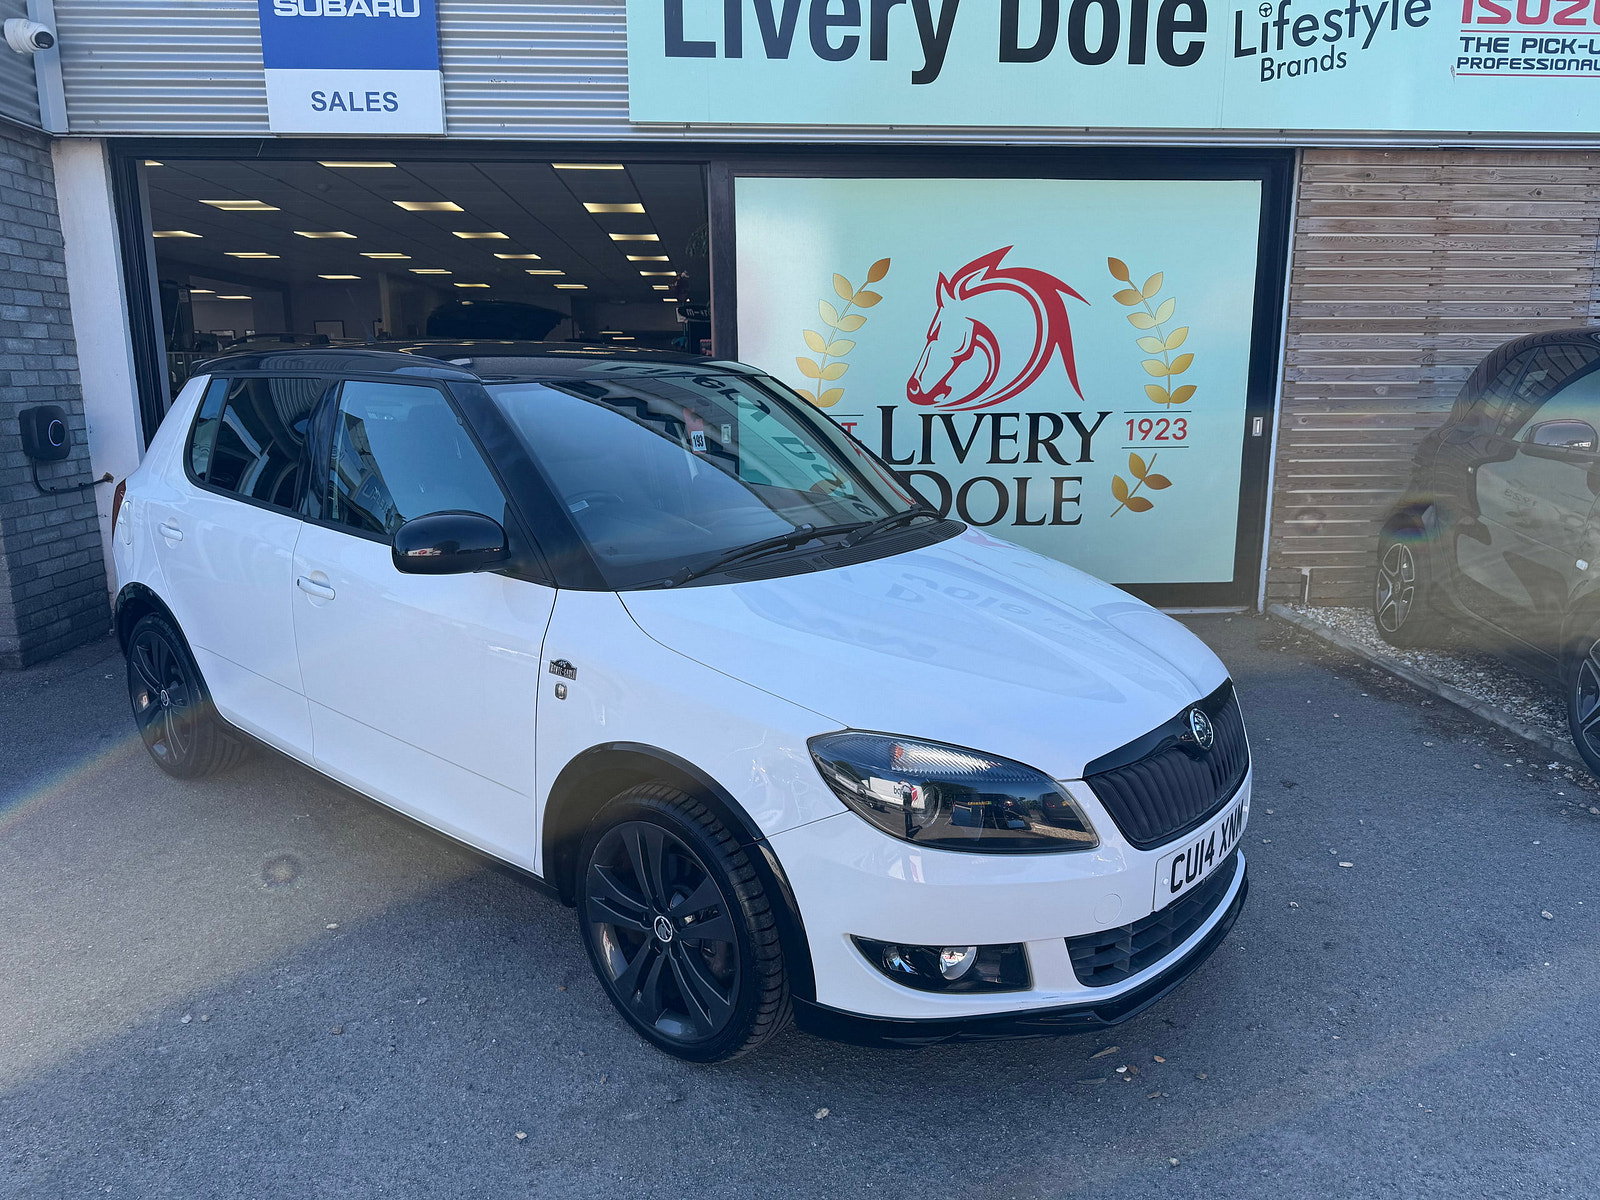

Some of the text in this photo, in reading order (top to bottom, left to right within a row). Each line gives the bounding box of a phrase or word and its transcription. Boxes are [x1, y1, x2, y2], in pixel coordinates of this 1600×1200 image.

[274, 0, 421, 18] SUBARU
[1461, 0, 1600, 25] ISUZ
[664, 0, 1207, 85] Livery Dole
[1234, 0, 1431, 58] Lifestyle
[1459, 37, 1510, 53] THE
[1260, 45, 1347, 82] Brands
[311, 91, 399, 112] SALES
[876, 405, 1113, 466] LIVERY
[1125, 418, 1188, 441] 1923
[1170, 831, 1216, 893] CU14
